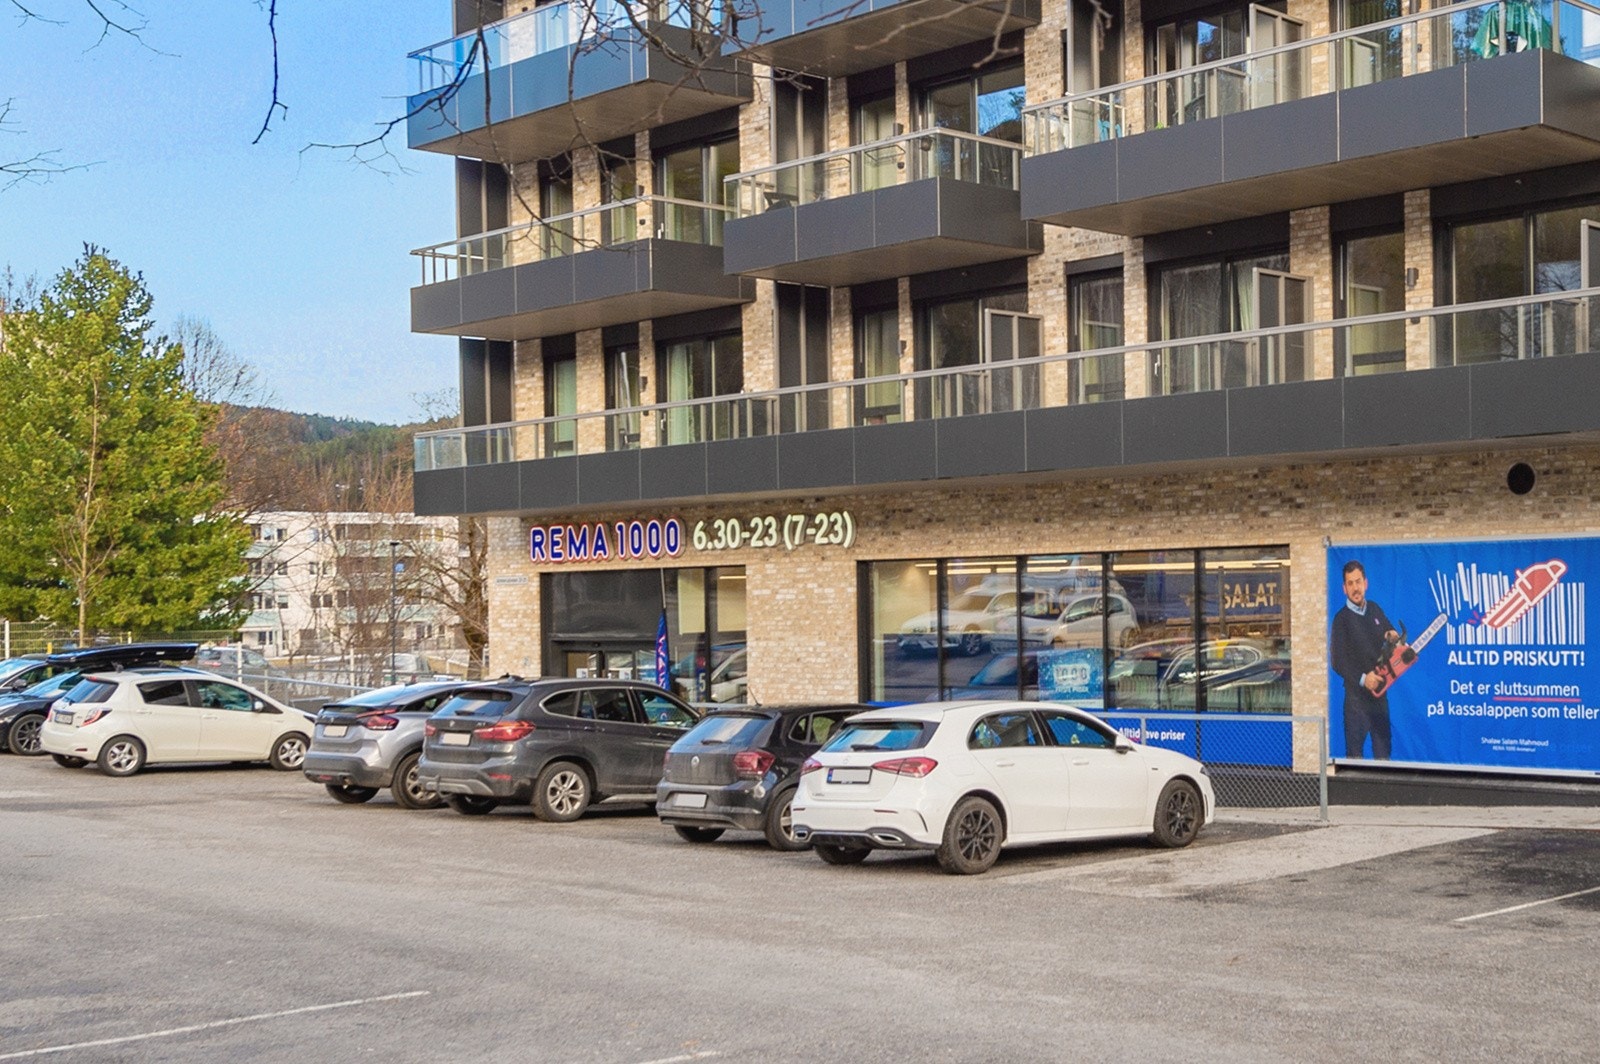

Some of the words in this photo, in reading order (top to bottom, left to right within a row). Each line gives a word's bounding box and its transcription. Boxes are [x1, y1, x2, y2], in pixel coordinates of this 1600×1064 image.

[530, 522, 609, 562] REMA
[615, 518, 680, 559] 1000
[693, 515, 778, 550] 6.30-23
[783, 510, 853, 550] (7-23)
[1223, 582, 1277, 609] SALAT
[1447, 650, 1500, 666] ALLTID
[1503, 650, 1585, 667] PRISKUTT!
[1450, 679, 1474, 694] Det
[1477, 683, 1490, 695] er
[1494, 681, 1580, 697] sluttsummen
[1427, 700, 1444, 717] på
[1448, 702, 1528, 720] kassalappen
[1531, 707, 1560, 718] som
[1563, 705, 1599, 720] teller
[1160, 729, 1186, 741] priser
